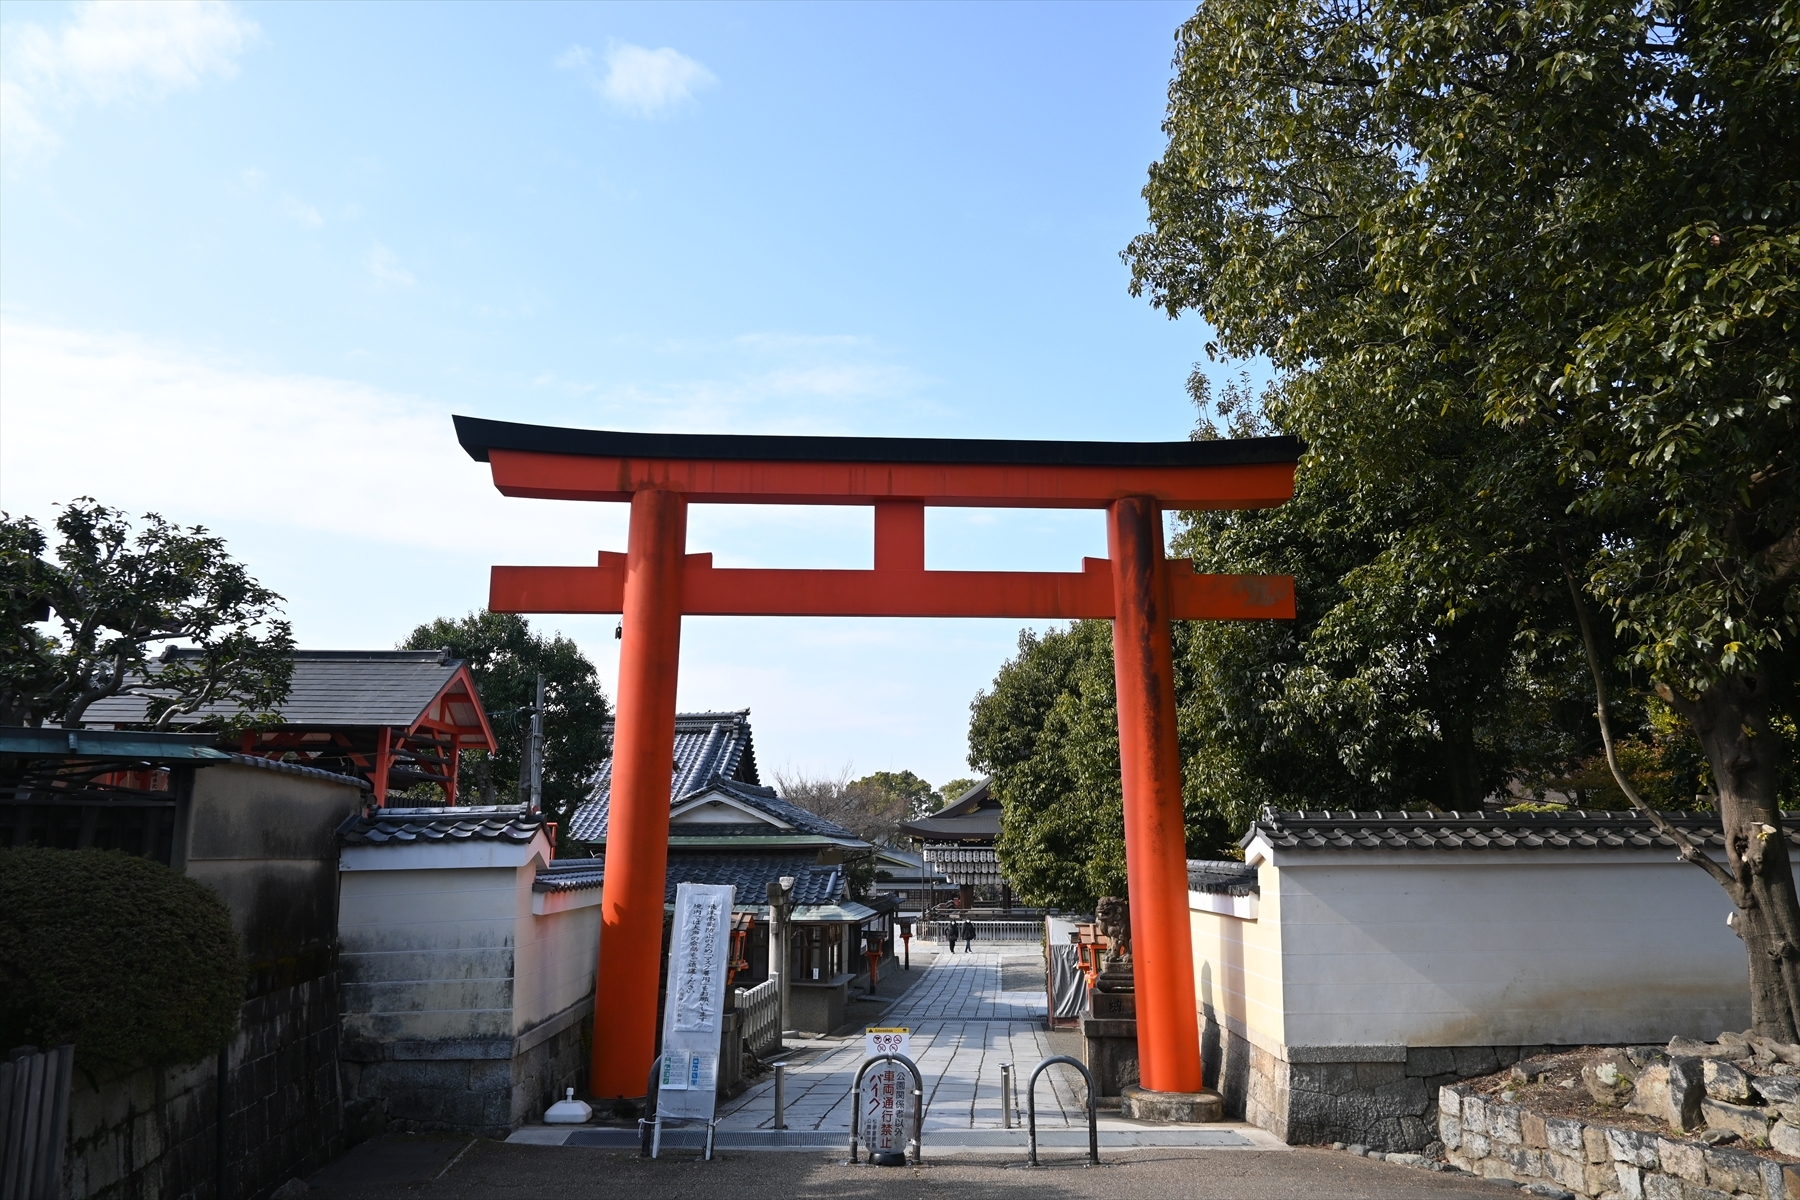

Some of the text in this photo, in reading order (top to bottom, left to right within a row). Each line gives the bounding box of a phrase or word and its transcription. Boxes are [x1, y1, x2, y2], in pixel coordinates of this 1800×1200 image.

[869, 1074, 883, 1115] バイク
[881, 1070, 895, 1148] 車両通行禁止
[895, 1072, 905, 1136] 公園関係者以外
